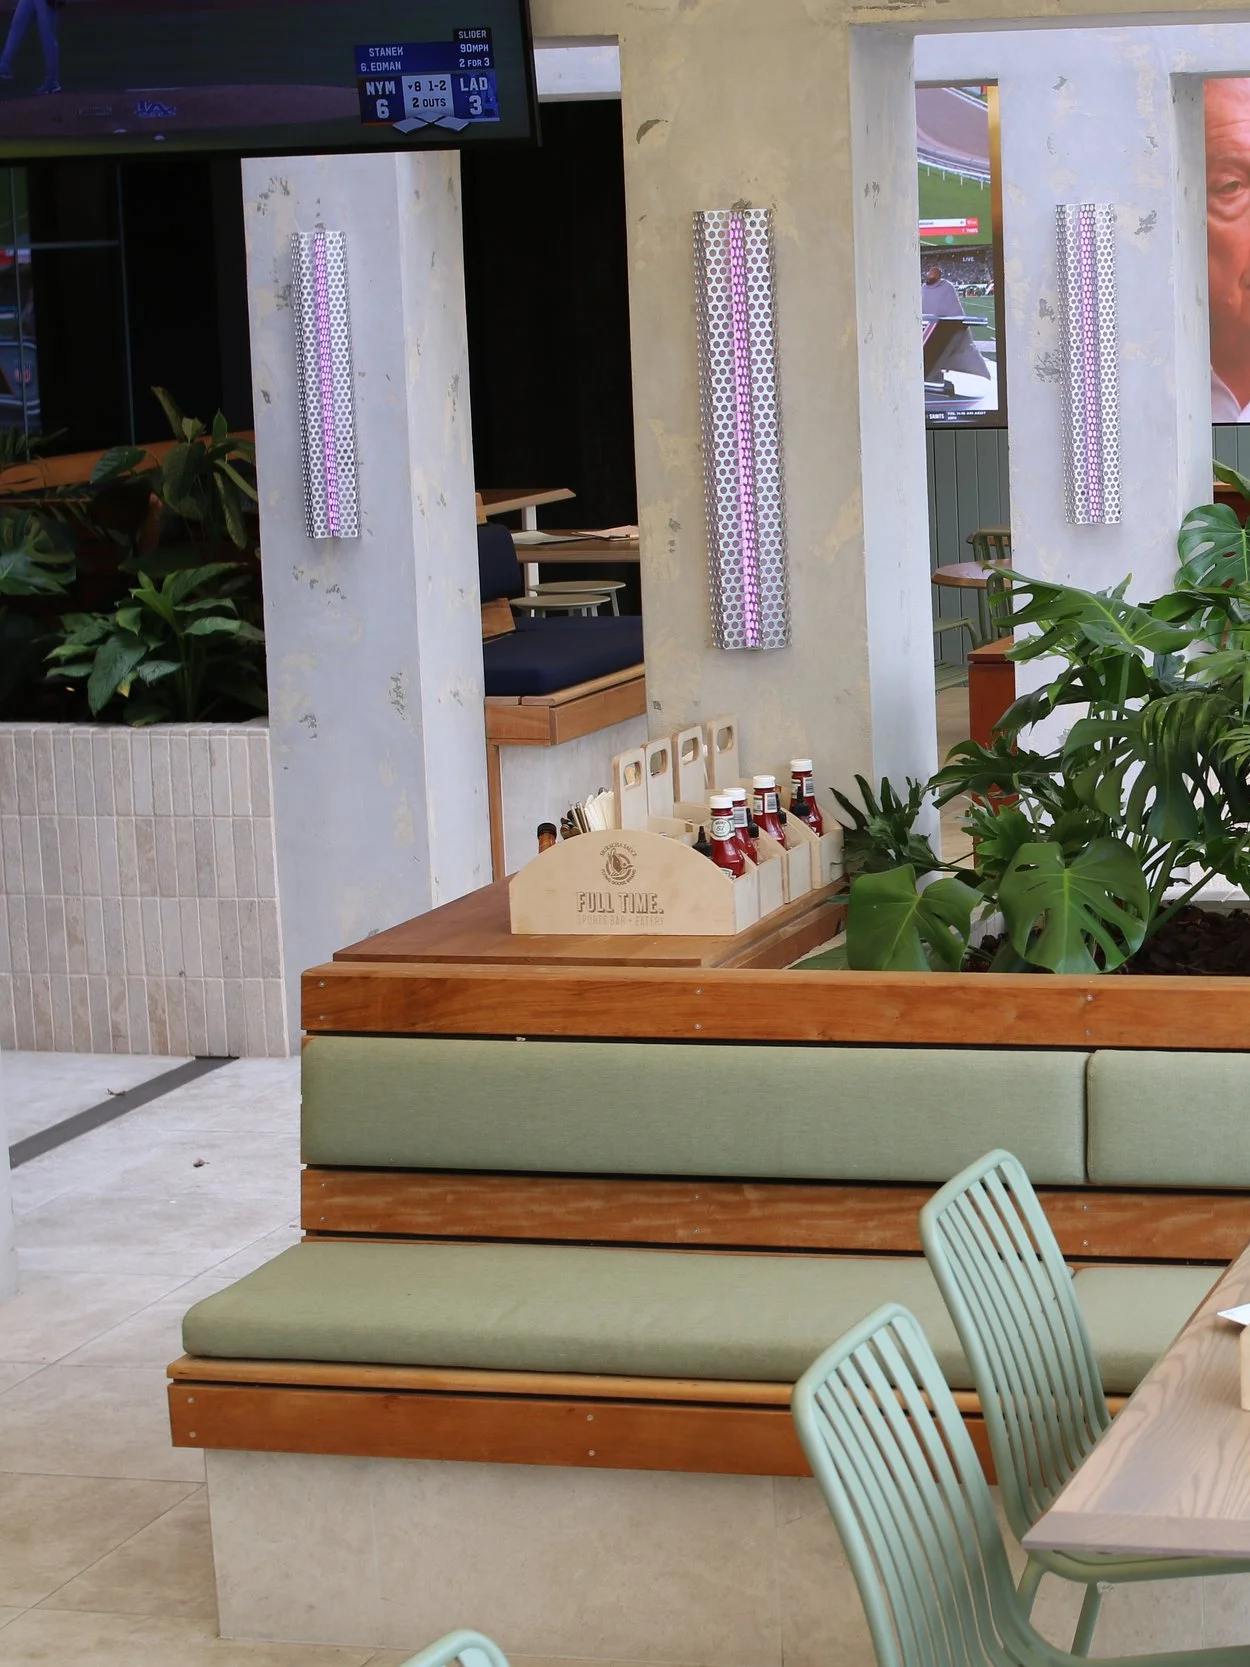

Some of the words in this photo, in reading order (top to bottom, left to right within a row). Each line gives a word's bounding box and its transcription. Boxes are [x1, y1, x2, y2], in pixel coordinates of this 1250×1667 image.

[458, 30, 487, 39] SLIDER
[369, 46, 404, 57] STANEK
[460, 43, 489, 53] 90MPH
[459, 58, 466, 68] 2
[467, 59, 482, 67] FOR
[484, 57, 490, 66] 3
[366, 80, 396, 96] NYM
[429, 80, 447, 91] 1-2
[460, 77, 489, 92] LAD
[412, 97, 420, 108] 2
[423, 98, 446, 108] OUTS
[469, 95, 483, 116] 3
[375, 99, 390, 119] 6
[576, 891, 615, 913] FULL
[617, 892, 665, 914] TIME.
[610, 915, 626, 926] BAR
